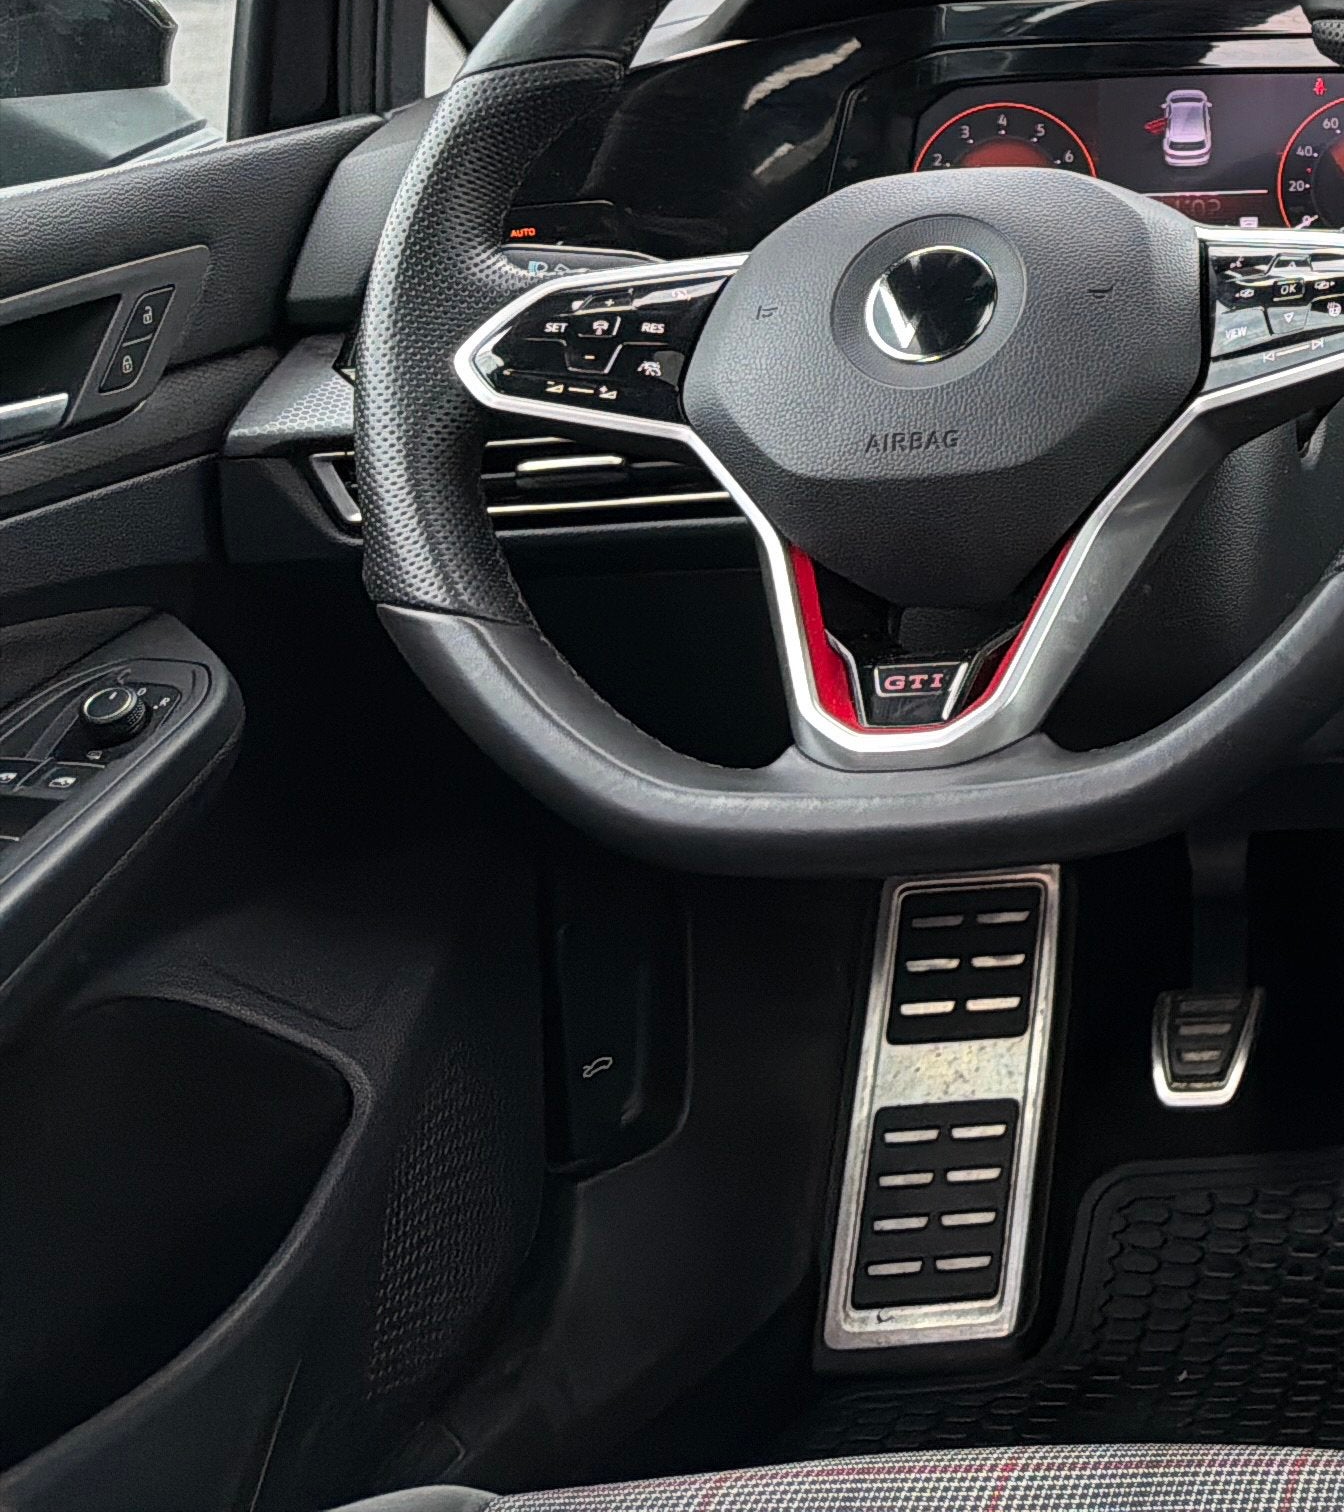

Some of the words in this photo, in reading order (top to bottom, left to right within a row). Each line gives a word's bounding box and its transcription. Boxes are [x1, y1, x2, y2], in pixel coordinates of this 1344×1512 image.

[997, 114, 1007, 126] 4
[1322, 117, 1339, 130] 60
[961, 125, 971, 139] 3
[1036, 123, 1046, 137] 5
[1064, 150, 1074, 163] 6
[1296, 145, 1313, 158] 40
[932, 154, 943, 166] 2
[1288, 179, 1306, 192] 20
[510, 227, 536, 238] AUTO
[1280, 283, 1297, 295] OK
[544, 322, 568, 333] SET
[641, 322, 665, 334] RES
[1225, 326, 1248, 339] VIEW
[865, 429, 960, 454] AIRBAG
[884, 673, 944, 692] GTI
